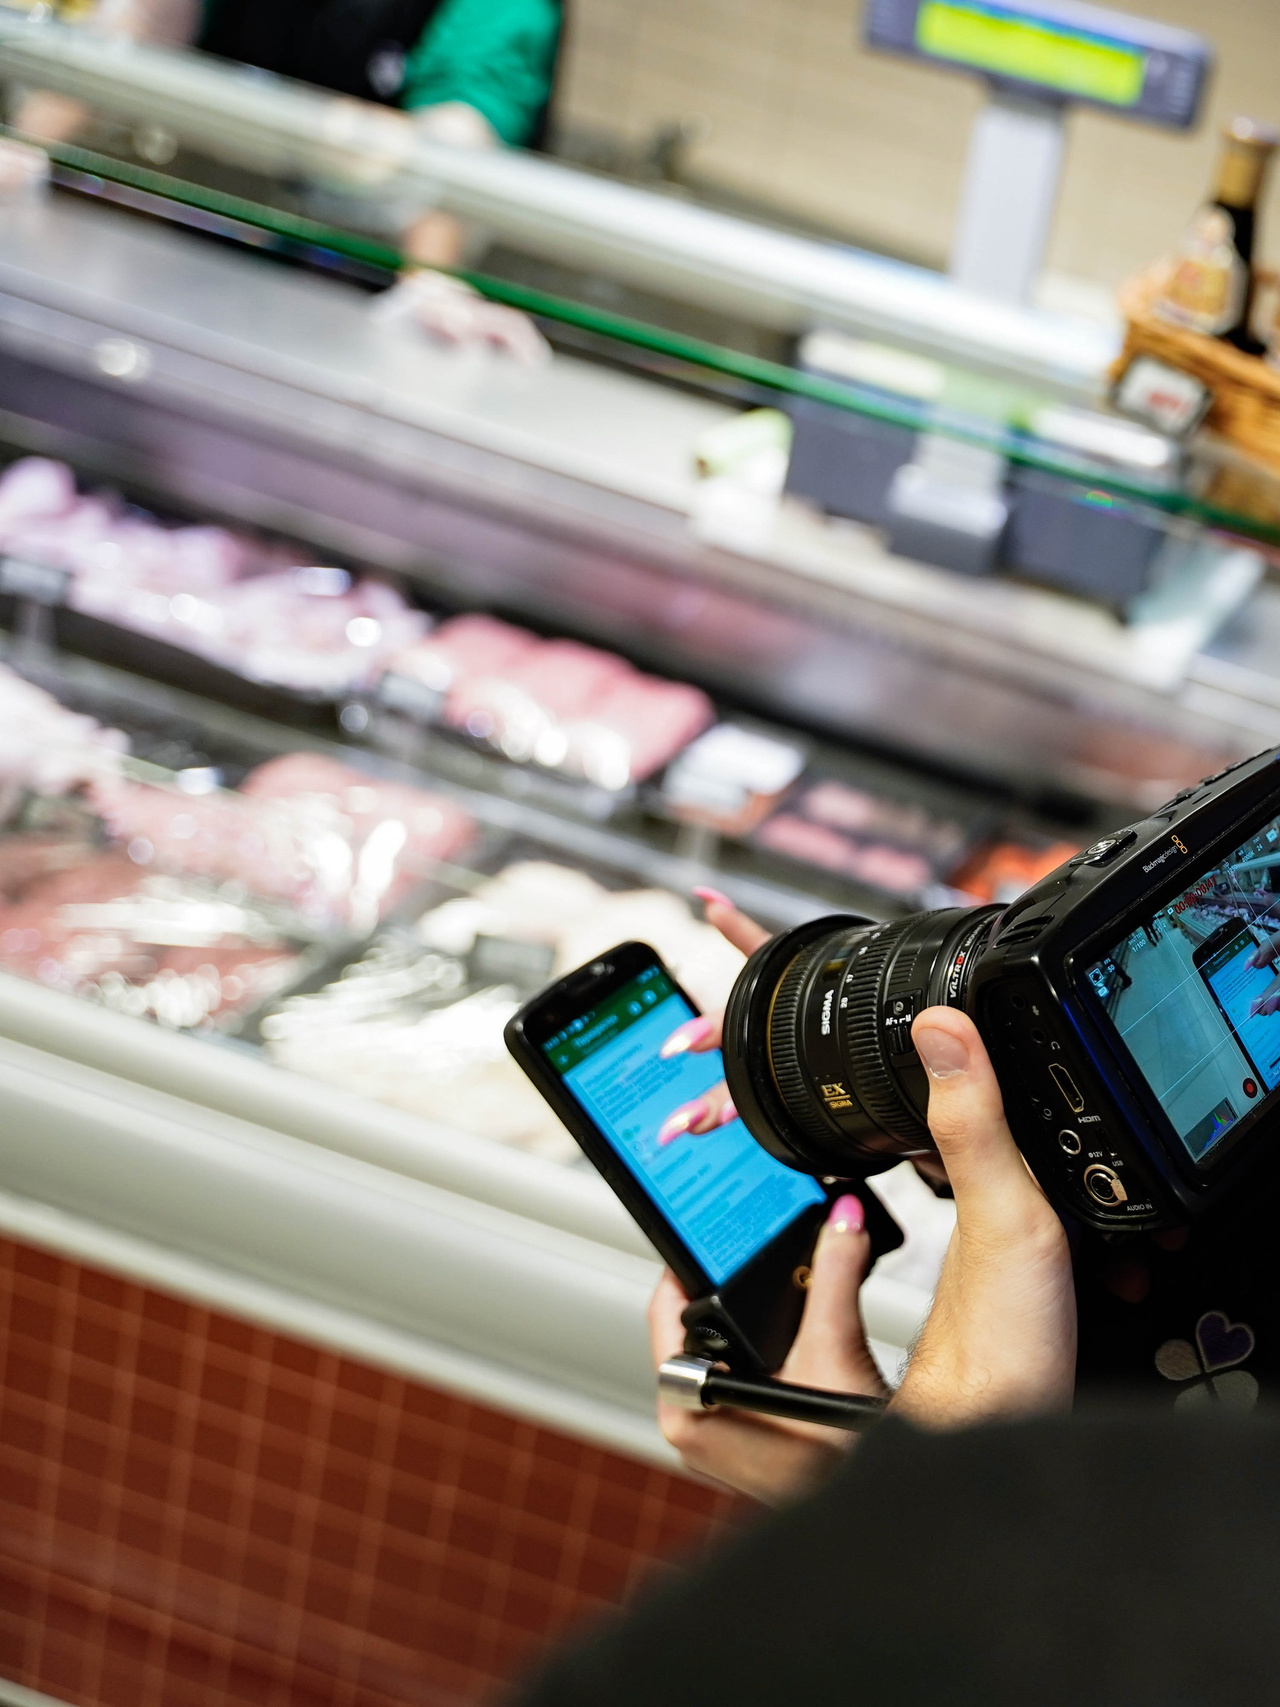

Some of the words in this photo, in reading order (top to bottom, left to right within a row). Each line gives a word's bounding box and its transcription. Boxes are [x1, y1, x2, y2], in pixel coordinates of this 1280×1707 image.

[1132, 939, 1146, 953] 1/100
[950, 951, 967, 998] VILTROX
[1107, 964, 1116, 973] 50
[821, 989, 835, 1036] SIGMA
[821, 1082, 846, 1097] EX
[829, 1099, 854, 1110] SIGMA
[1126, 1204, 1145, 1212] AUDIO
